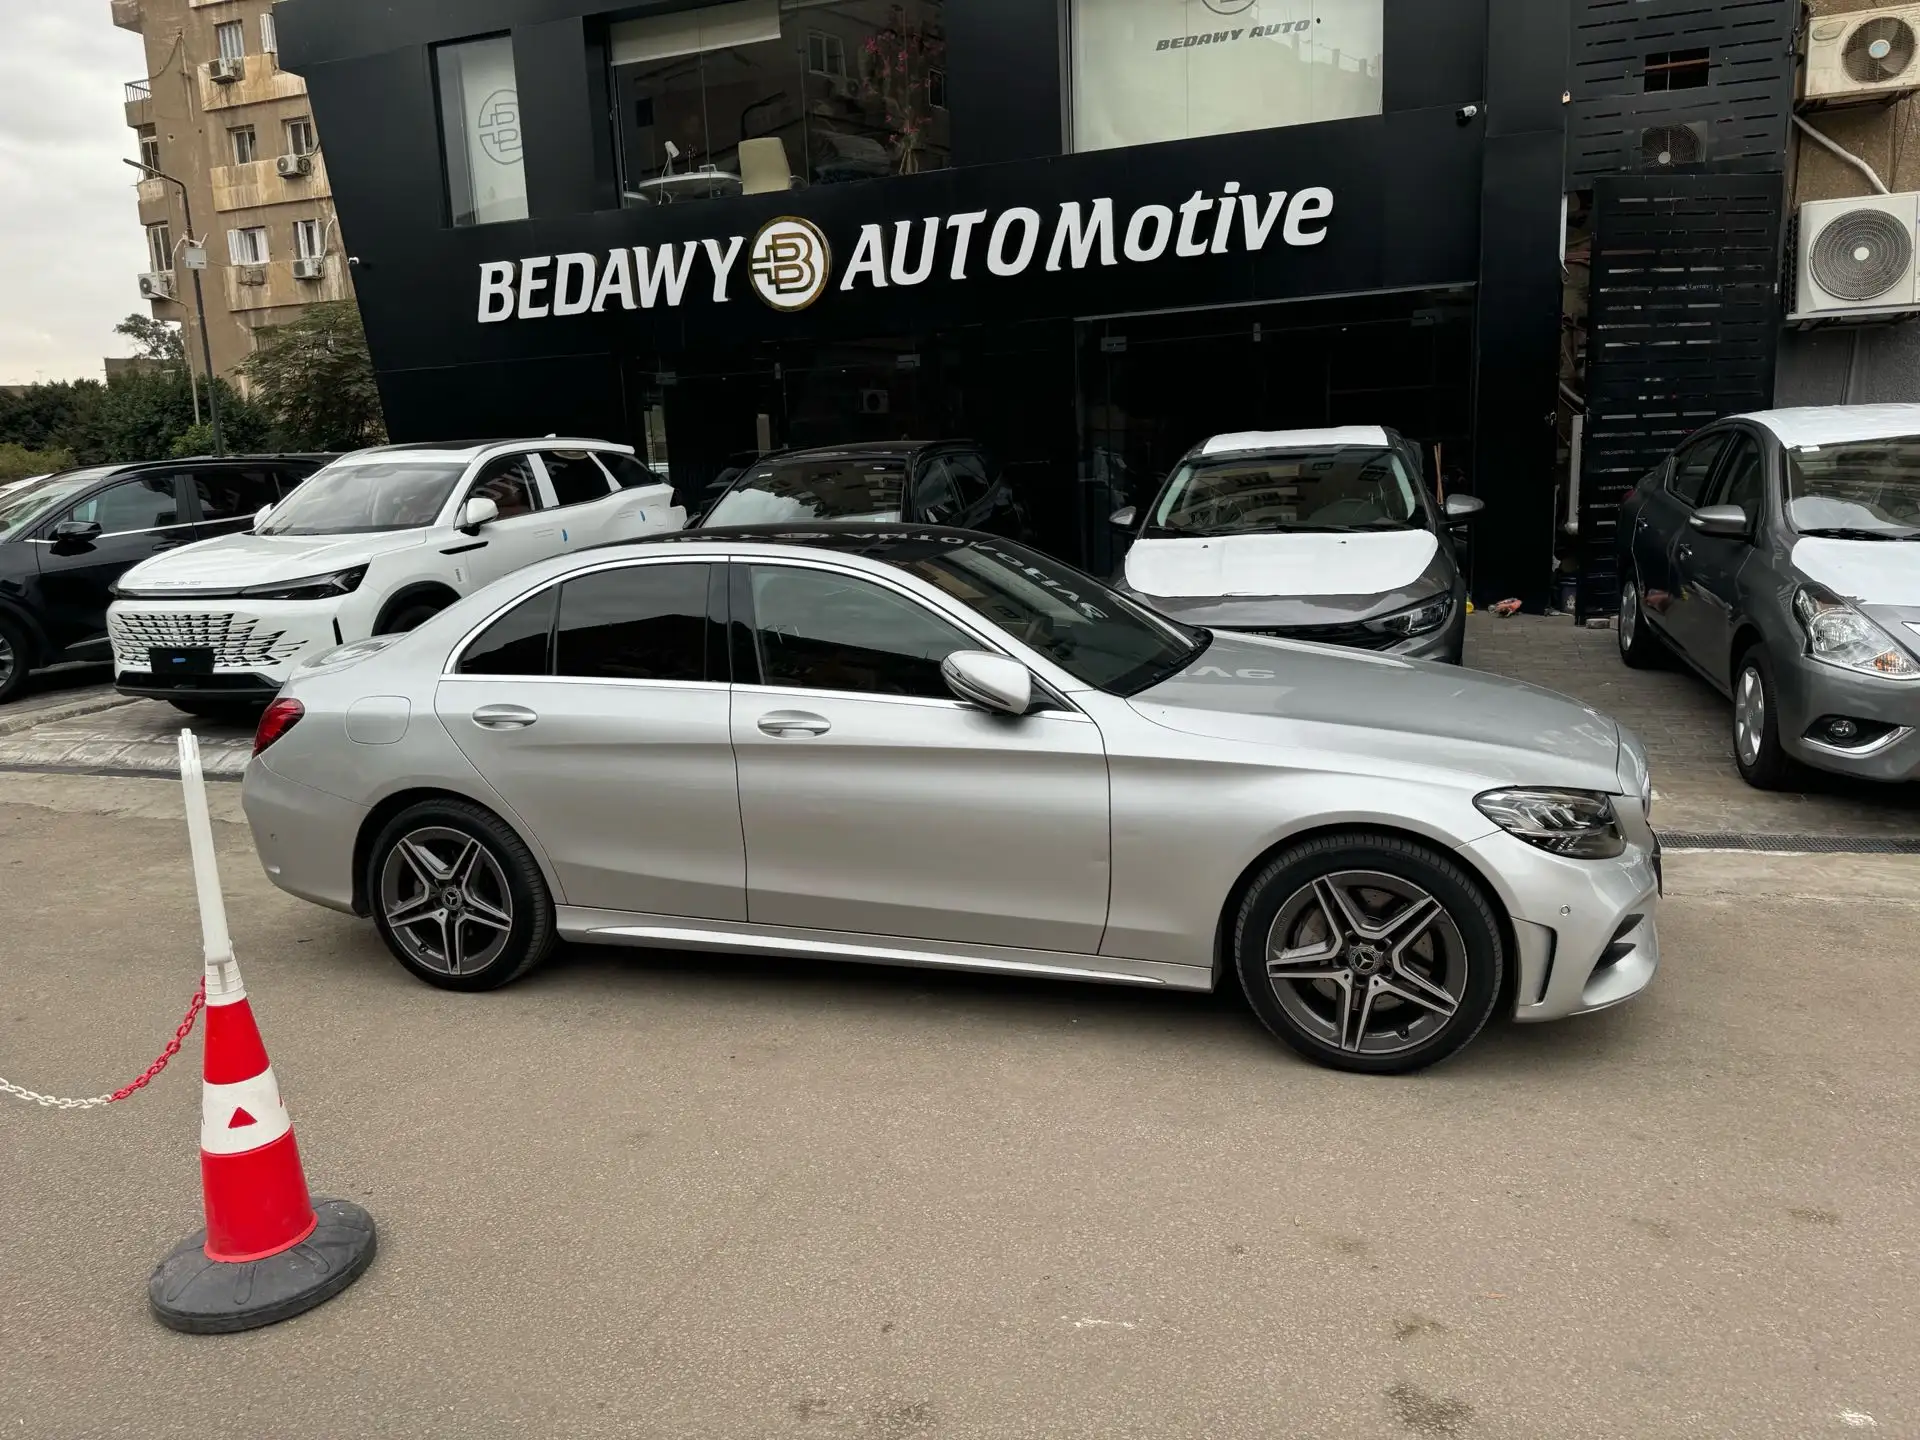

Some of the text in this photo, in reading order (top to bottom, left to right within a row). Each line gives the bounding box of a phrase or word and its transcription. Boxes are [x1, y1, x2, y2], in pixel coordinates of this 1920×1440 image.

[1156, 19, 1310, 51] BEDAWY AUTO
[477, 236, 746, 323] BEDAWY
